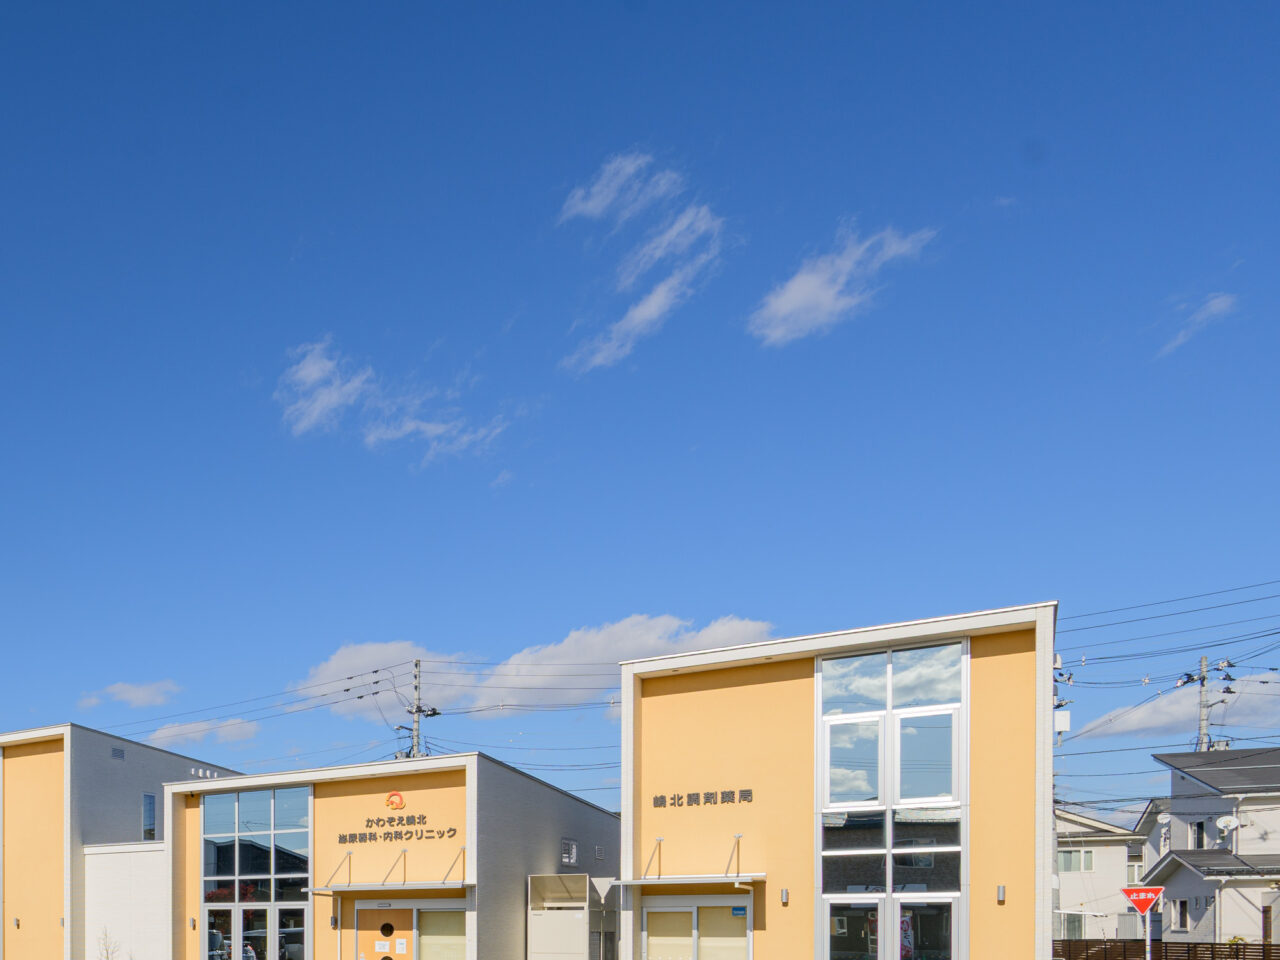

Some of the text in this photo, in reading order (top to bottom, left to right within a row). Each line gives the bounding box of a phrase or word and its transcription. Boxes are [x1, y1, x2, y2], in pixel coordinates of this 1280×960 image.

[653, 789, 753, 808] 嶋北調剤薬局
[365, 814, 427, 829] かわぞえ嶋北
[1130, 892, 1156, 900] 止まれ
